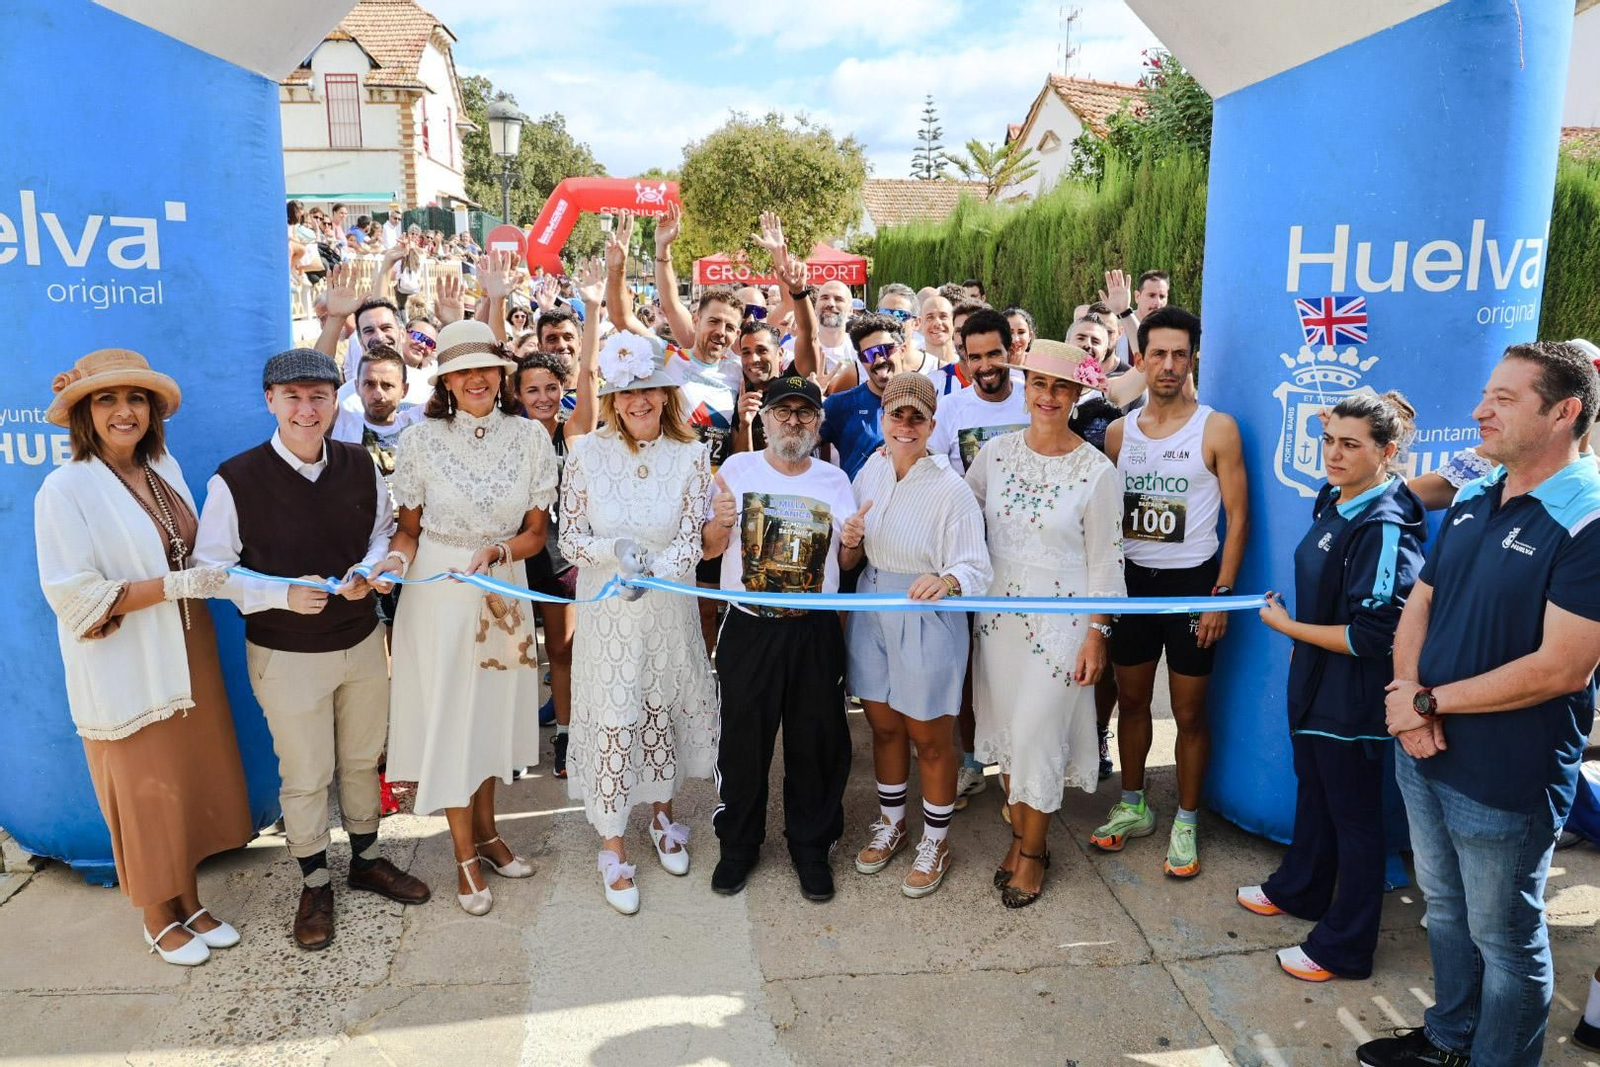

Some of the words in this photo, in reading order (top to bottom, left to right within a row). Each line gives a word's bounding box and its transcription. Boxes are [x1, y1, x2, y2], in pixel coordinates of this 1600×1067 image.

[1286, 219, 1544, 292] Huelva
[47, 278, 163, 309] original
[1476, 300, 1537, 329] original
[1287, 406, 1295, 431] MARIS
[1284, 433, 1293, 464] PORTUS
[1125, 470, 1189, 492] bathco
[1130, 508, 1176, 534] 100
[789, 537, 800, 562] 1
